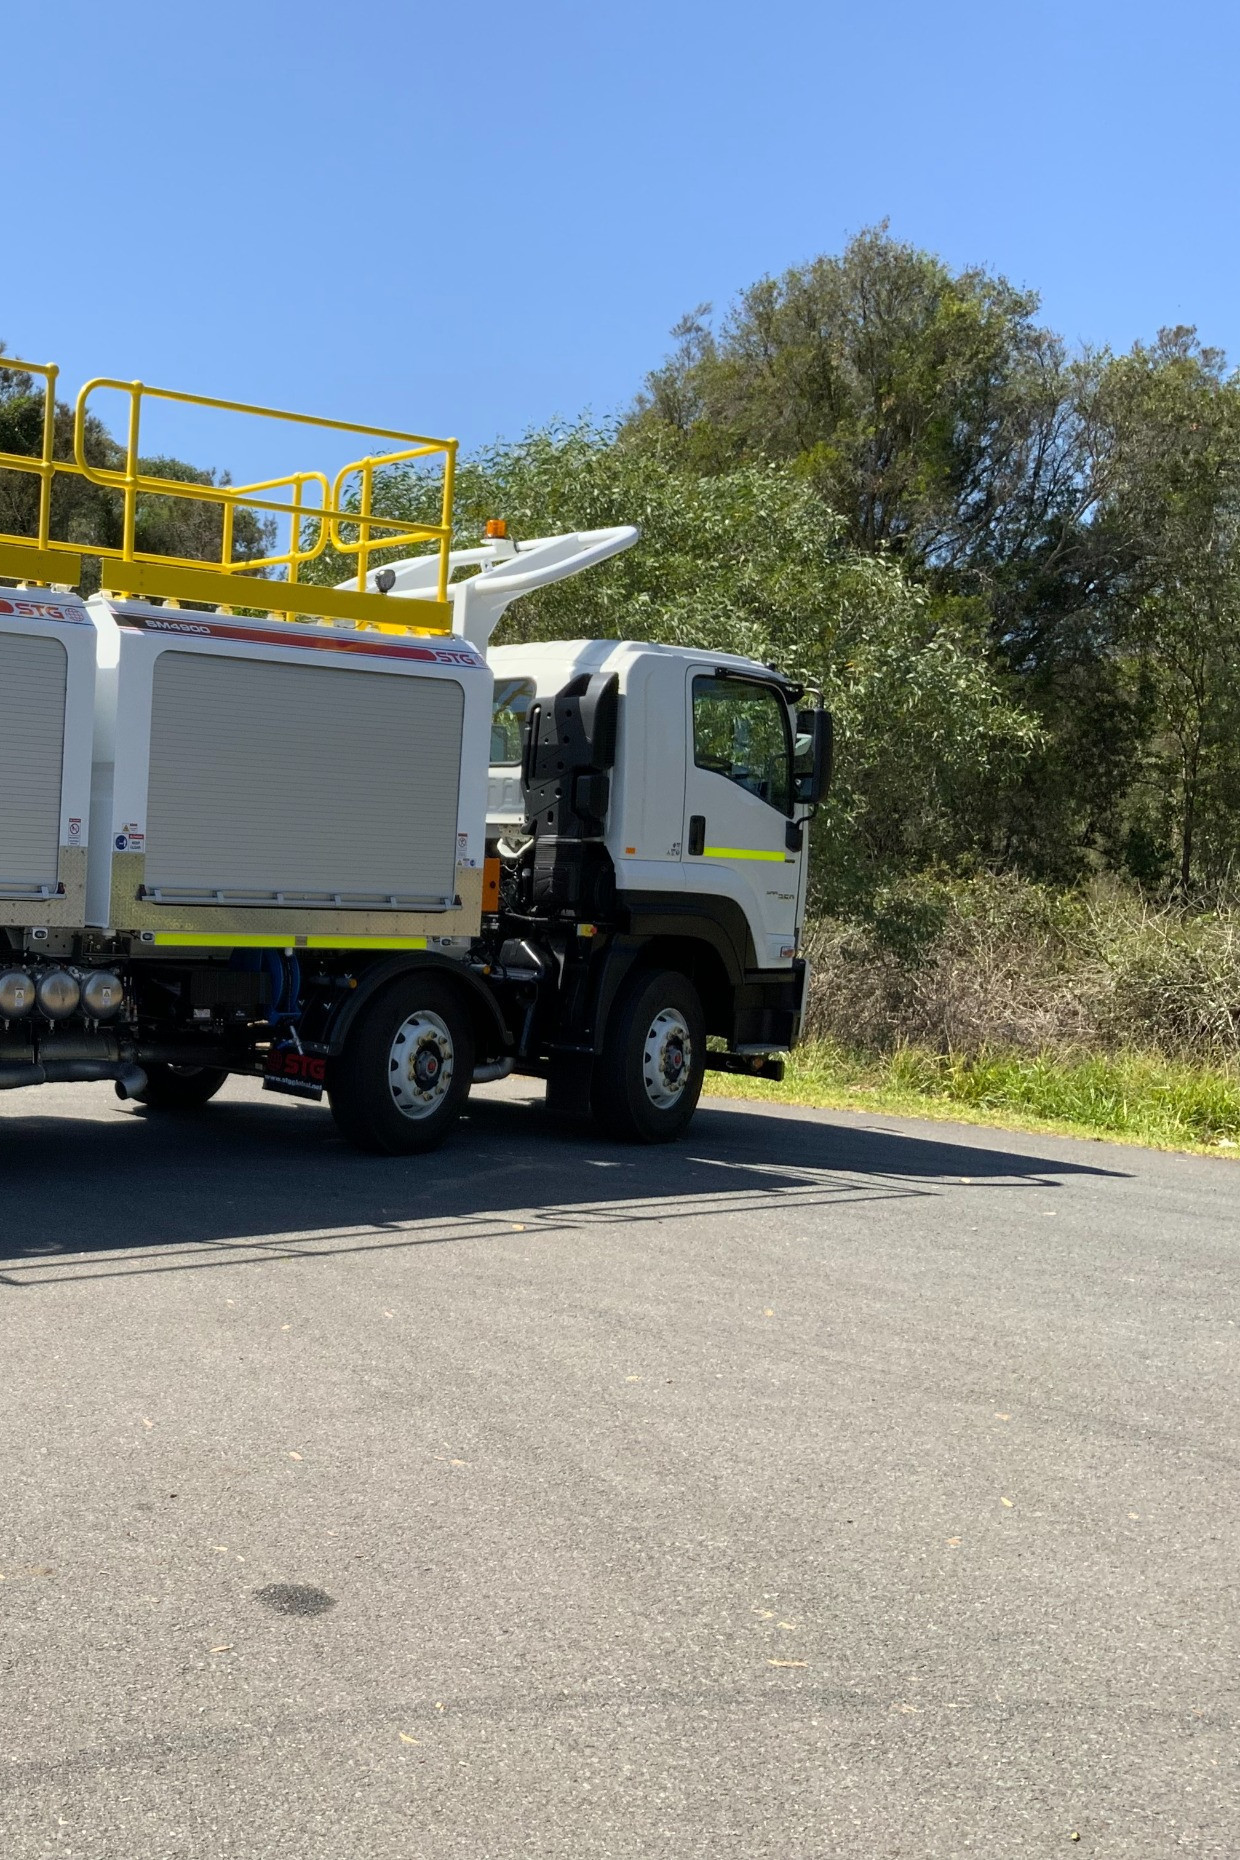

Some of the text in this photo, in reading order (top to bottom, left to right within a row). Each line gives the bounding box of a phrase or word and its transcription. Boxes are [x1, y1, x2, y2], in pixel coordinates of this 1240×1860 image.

[15, 603, 65, 619] STG
[435, 651, 476, 665] STG
[284, 1053, 327, 1080] STG
